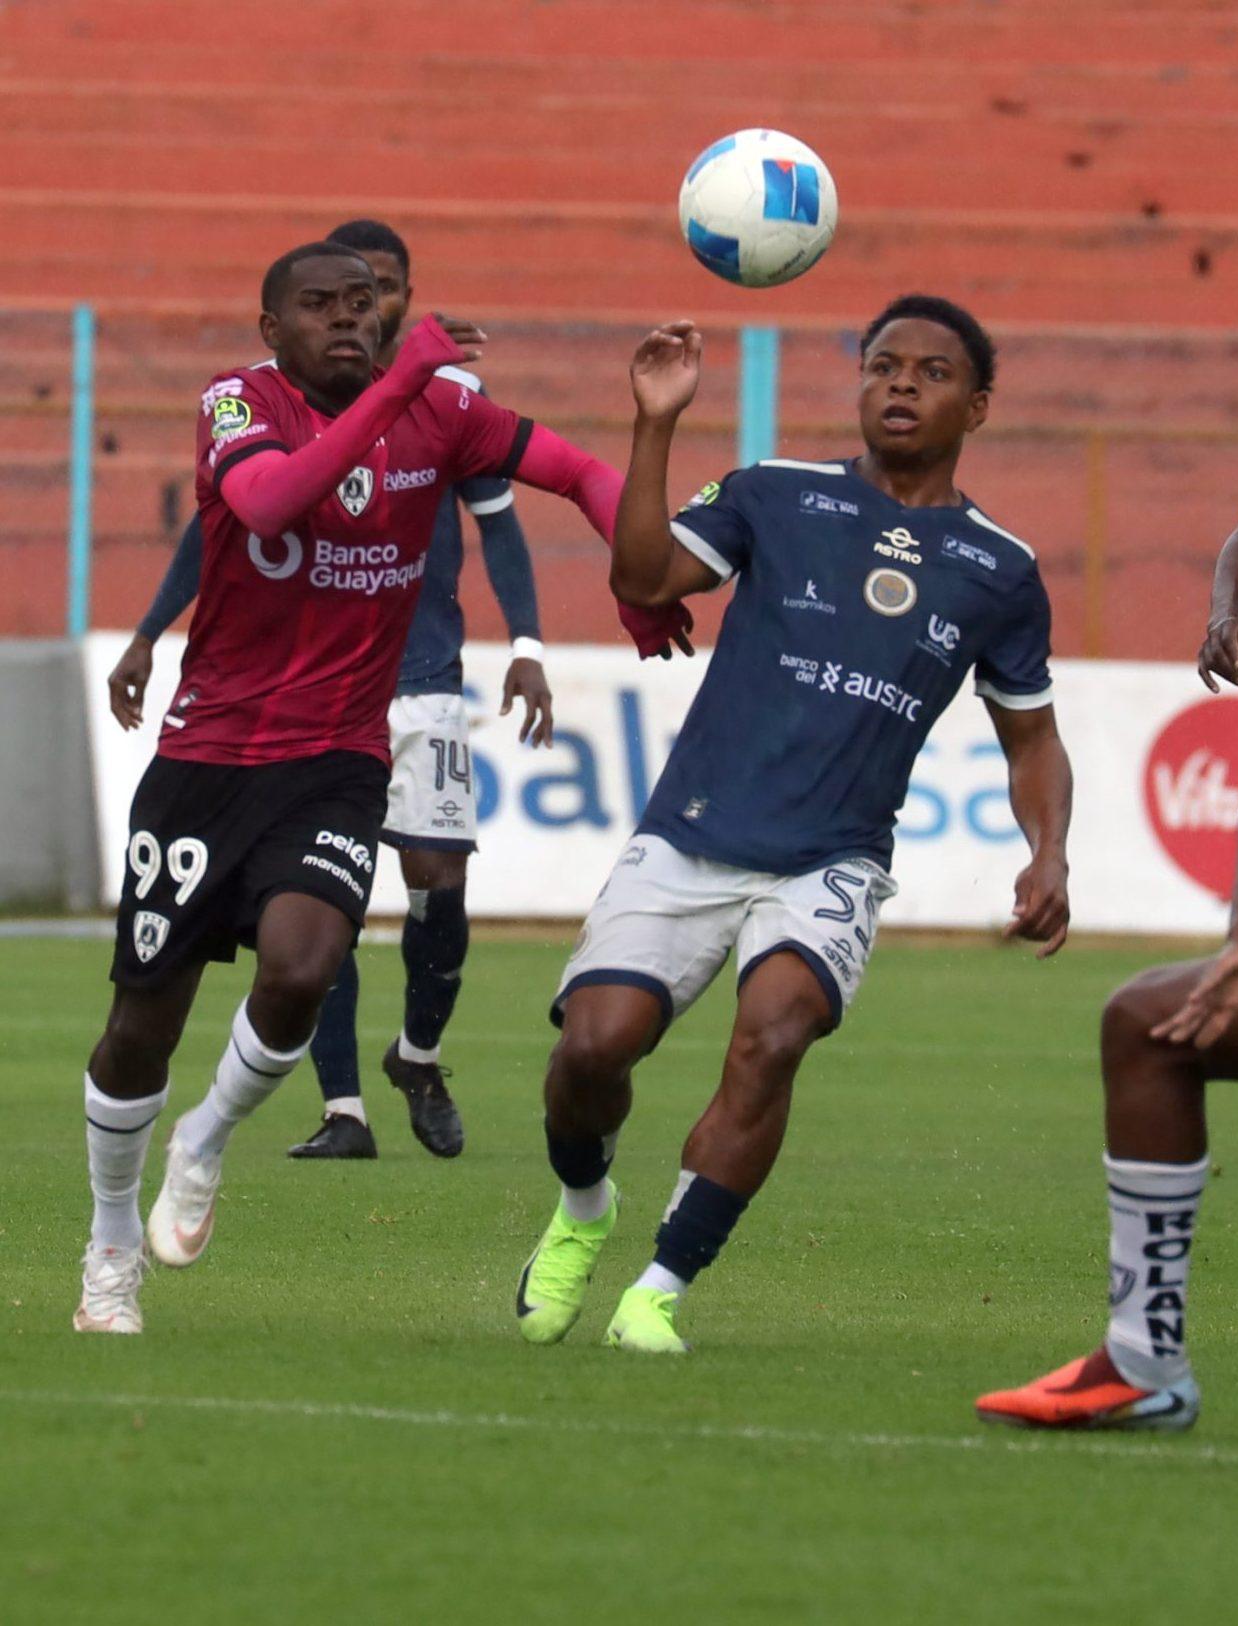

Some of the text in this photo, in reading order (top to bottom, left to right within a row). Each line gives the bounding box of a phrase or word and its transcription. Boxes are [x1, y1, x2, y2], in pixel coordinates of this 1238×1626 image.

[314, 539, 399, 566] Banco
[872, 541, 923, 566] ASTRO
[309, 552, 427, 595] Guayaquil
[927, 613, 961, 651] UC
[779, 652, 820, 672] banco
[794, 668, 817, 686] del
[128, 830, 208, 907] 99
[302, 854, 365, 900] marathon
